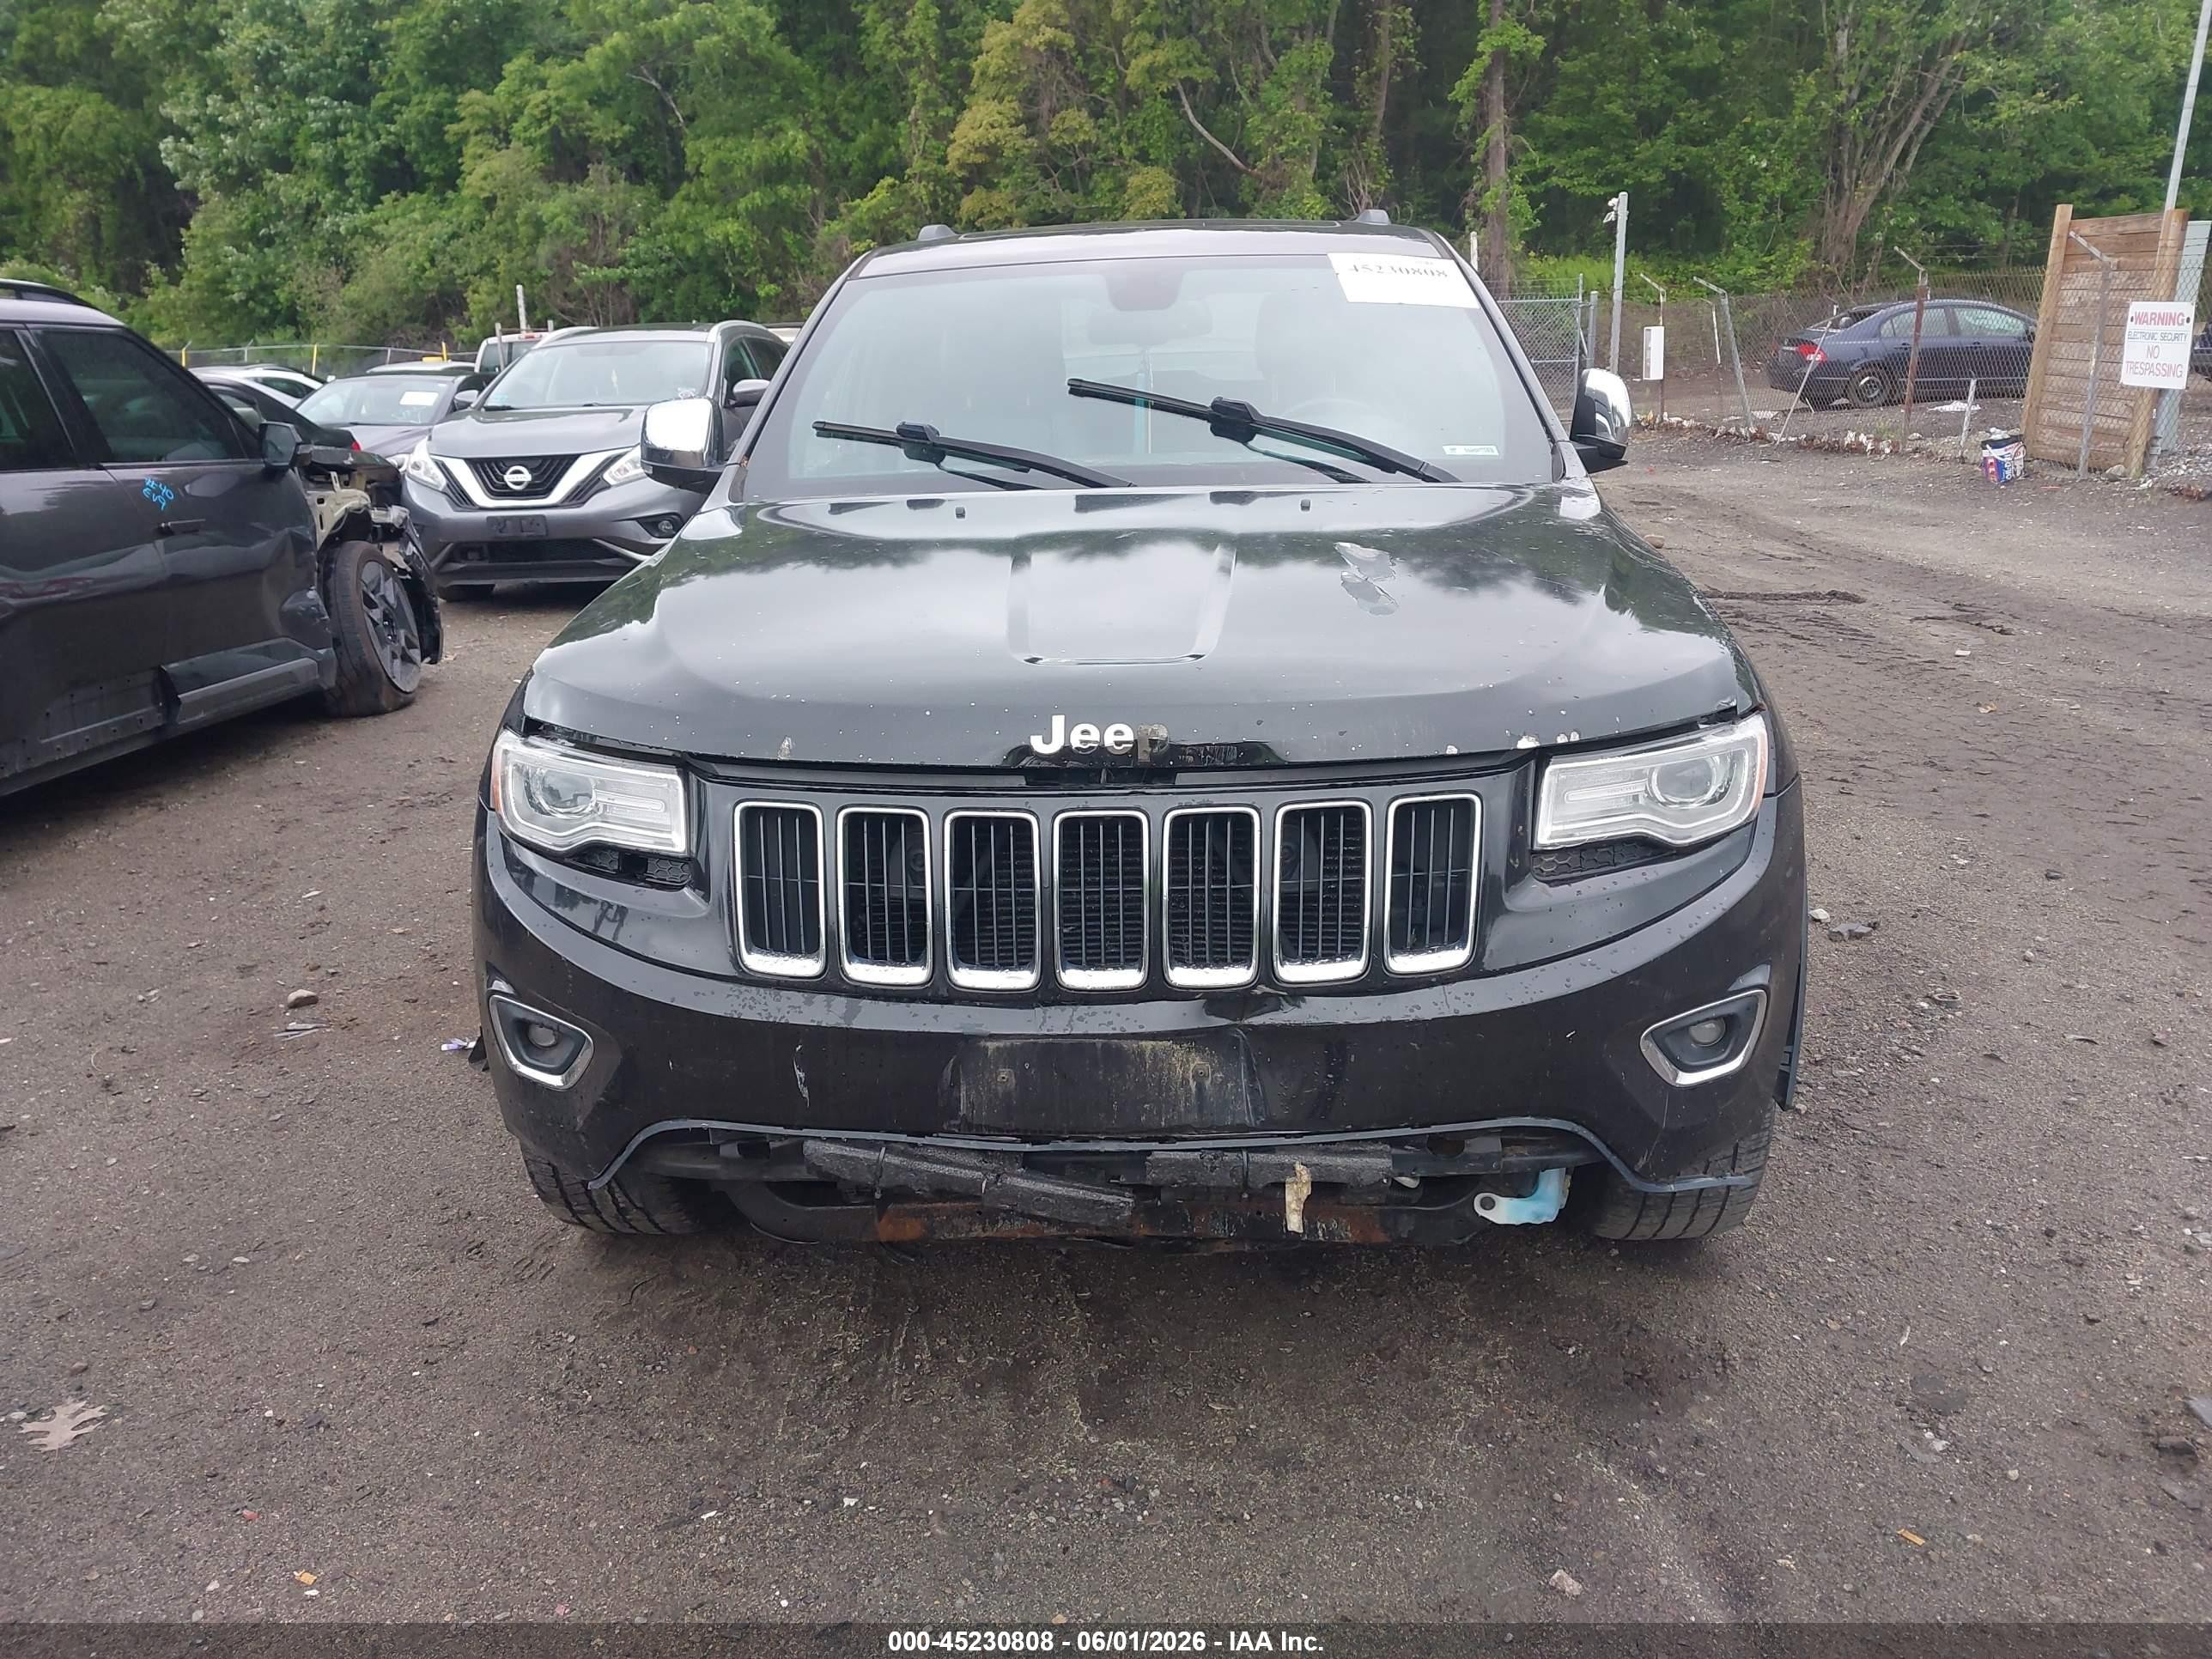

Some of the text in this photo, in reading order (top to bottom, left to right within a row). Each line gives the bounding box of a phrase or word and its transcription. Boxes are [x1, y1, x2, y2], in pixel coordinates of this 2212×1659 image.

[2134, 311, 2185, 326] WARNING
[2160, 331, 2188, 342] SECURITY
[2146, 344, 2160, 359] NO
[2125, 361, 2184, 378] TRESPASSING
